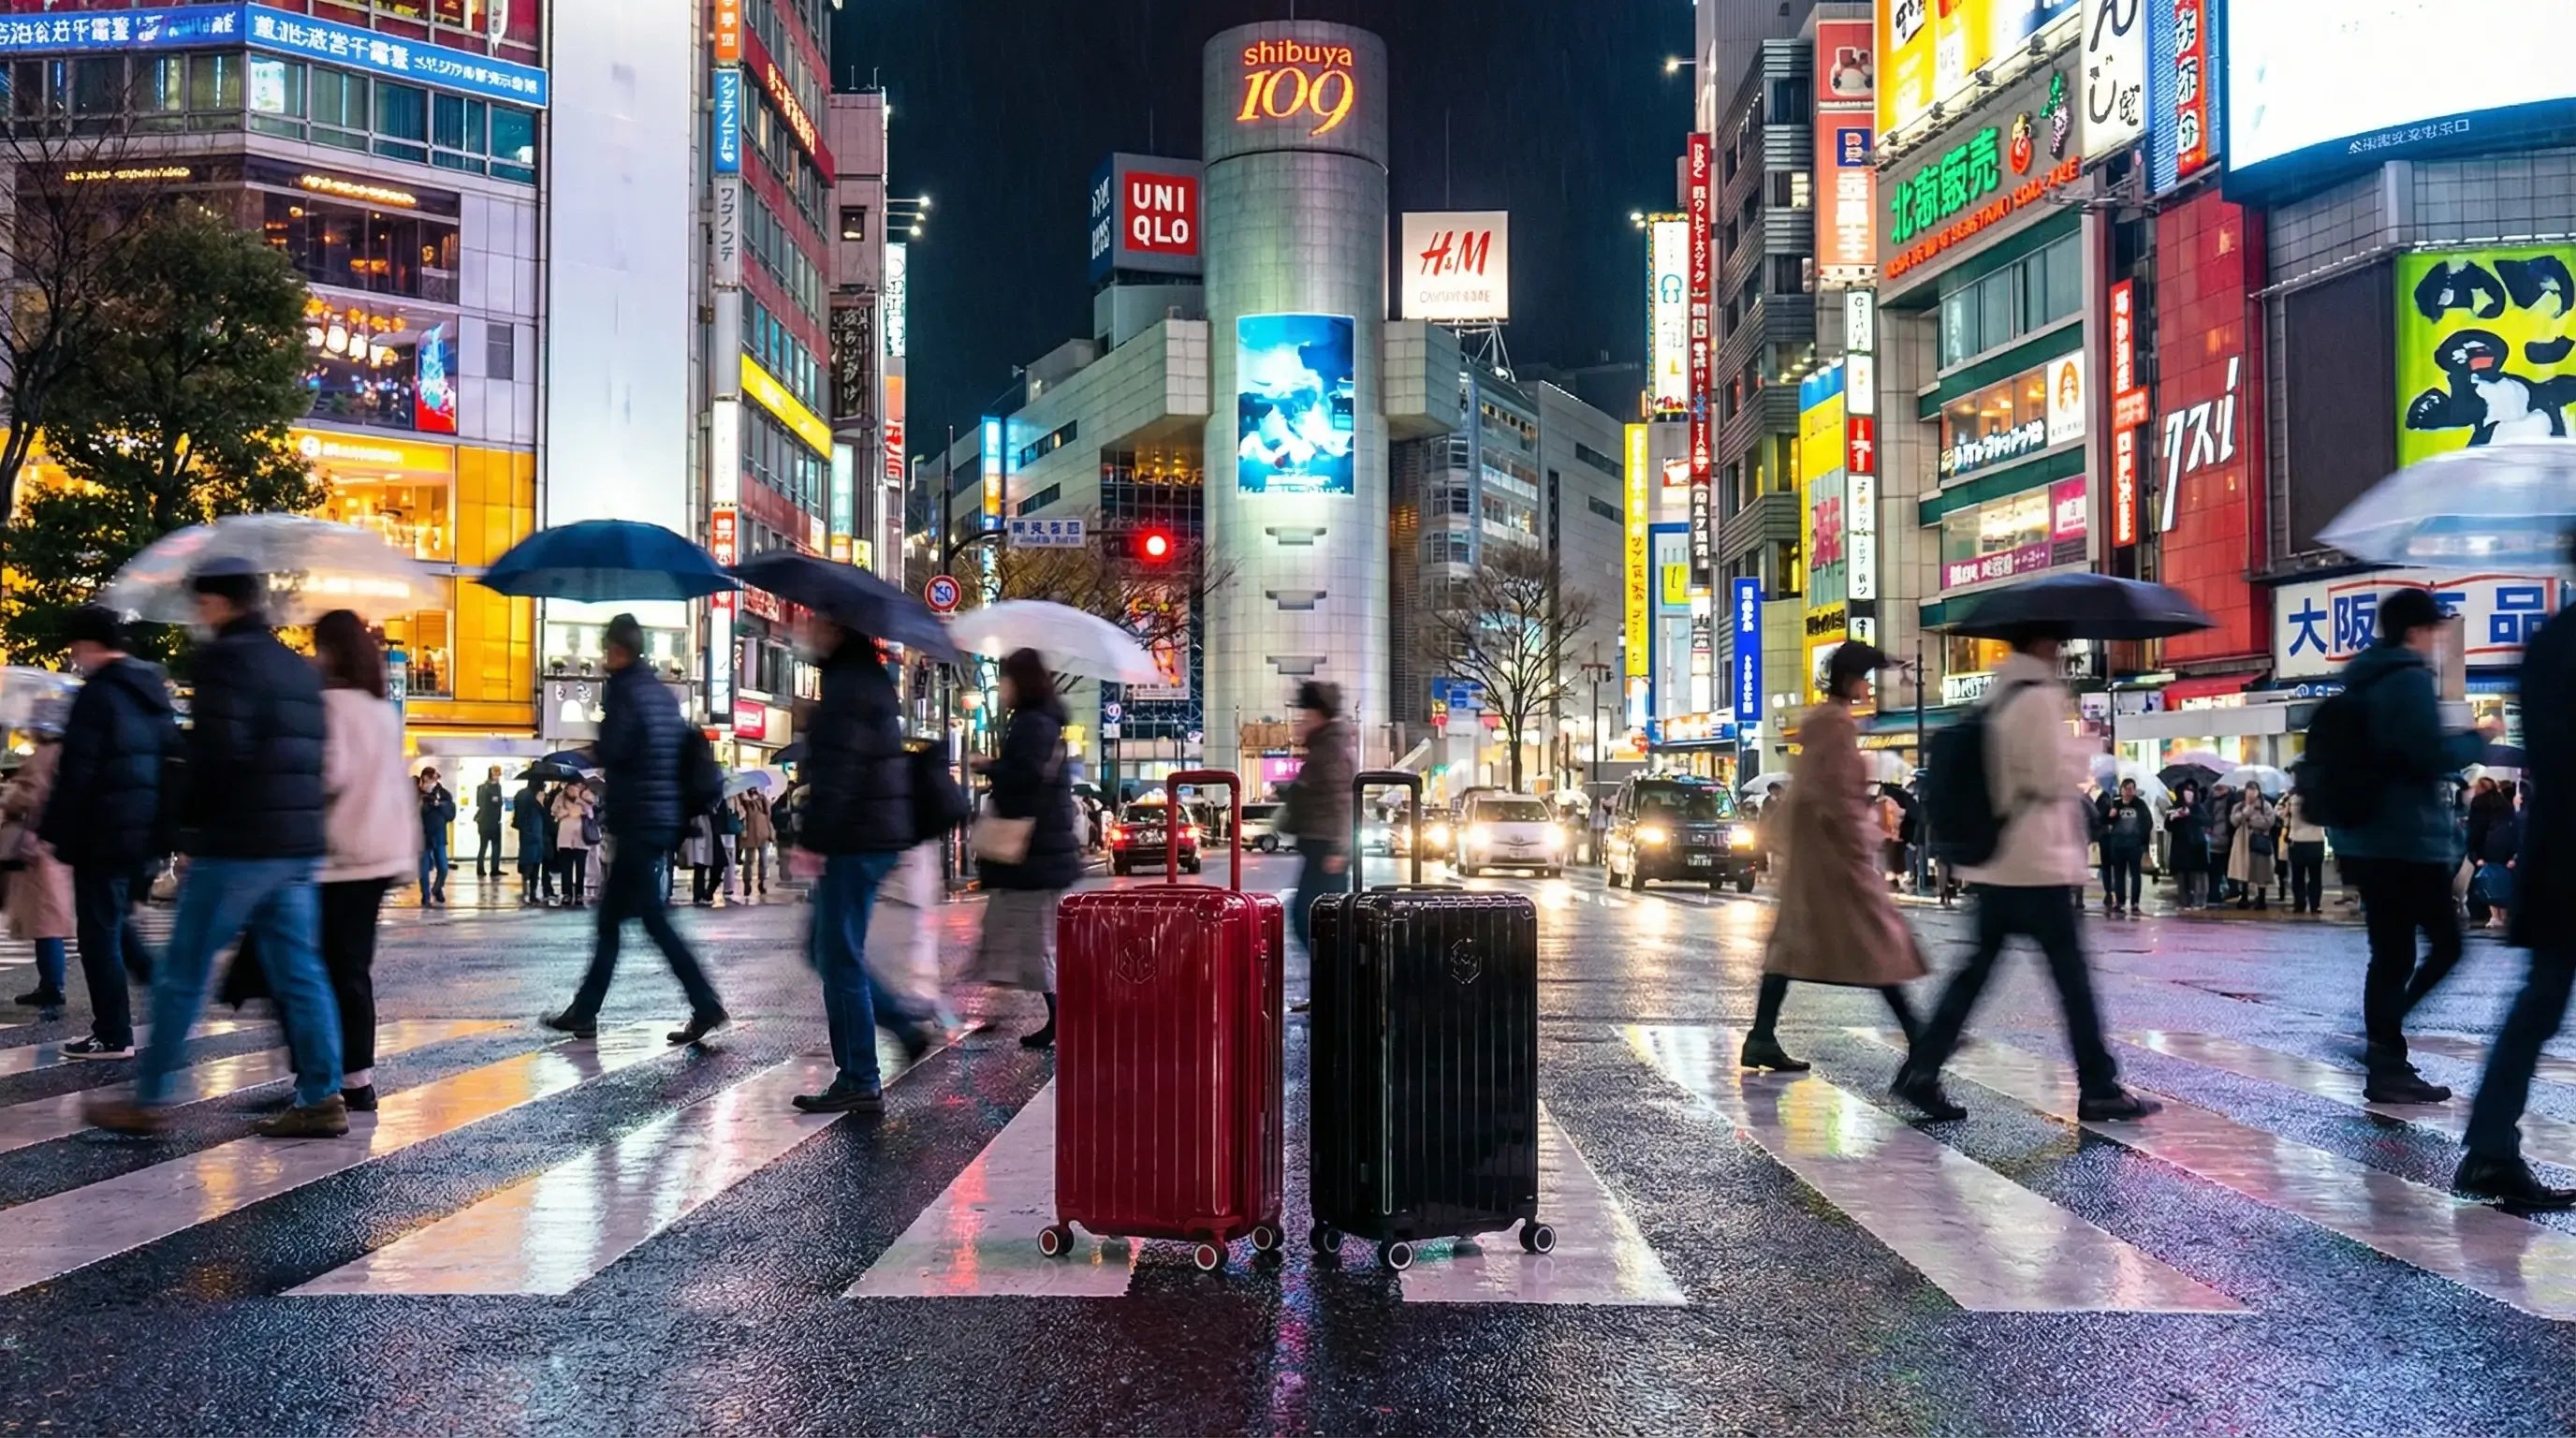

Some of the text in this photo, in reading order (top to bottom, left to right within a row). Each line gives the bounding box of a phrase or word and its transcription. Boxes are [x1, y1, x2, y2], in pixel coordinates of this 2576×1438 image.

[1244, 39, 1353, 68] shibuya
[1236, 66, 1354, 136] 109
[1133, 182, 1184, 213] UNI
[1133, 214, 1189, 246] QLO
[1420, 230, 1491, 276] H&M
